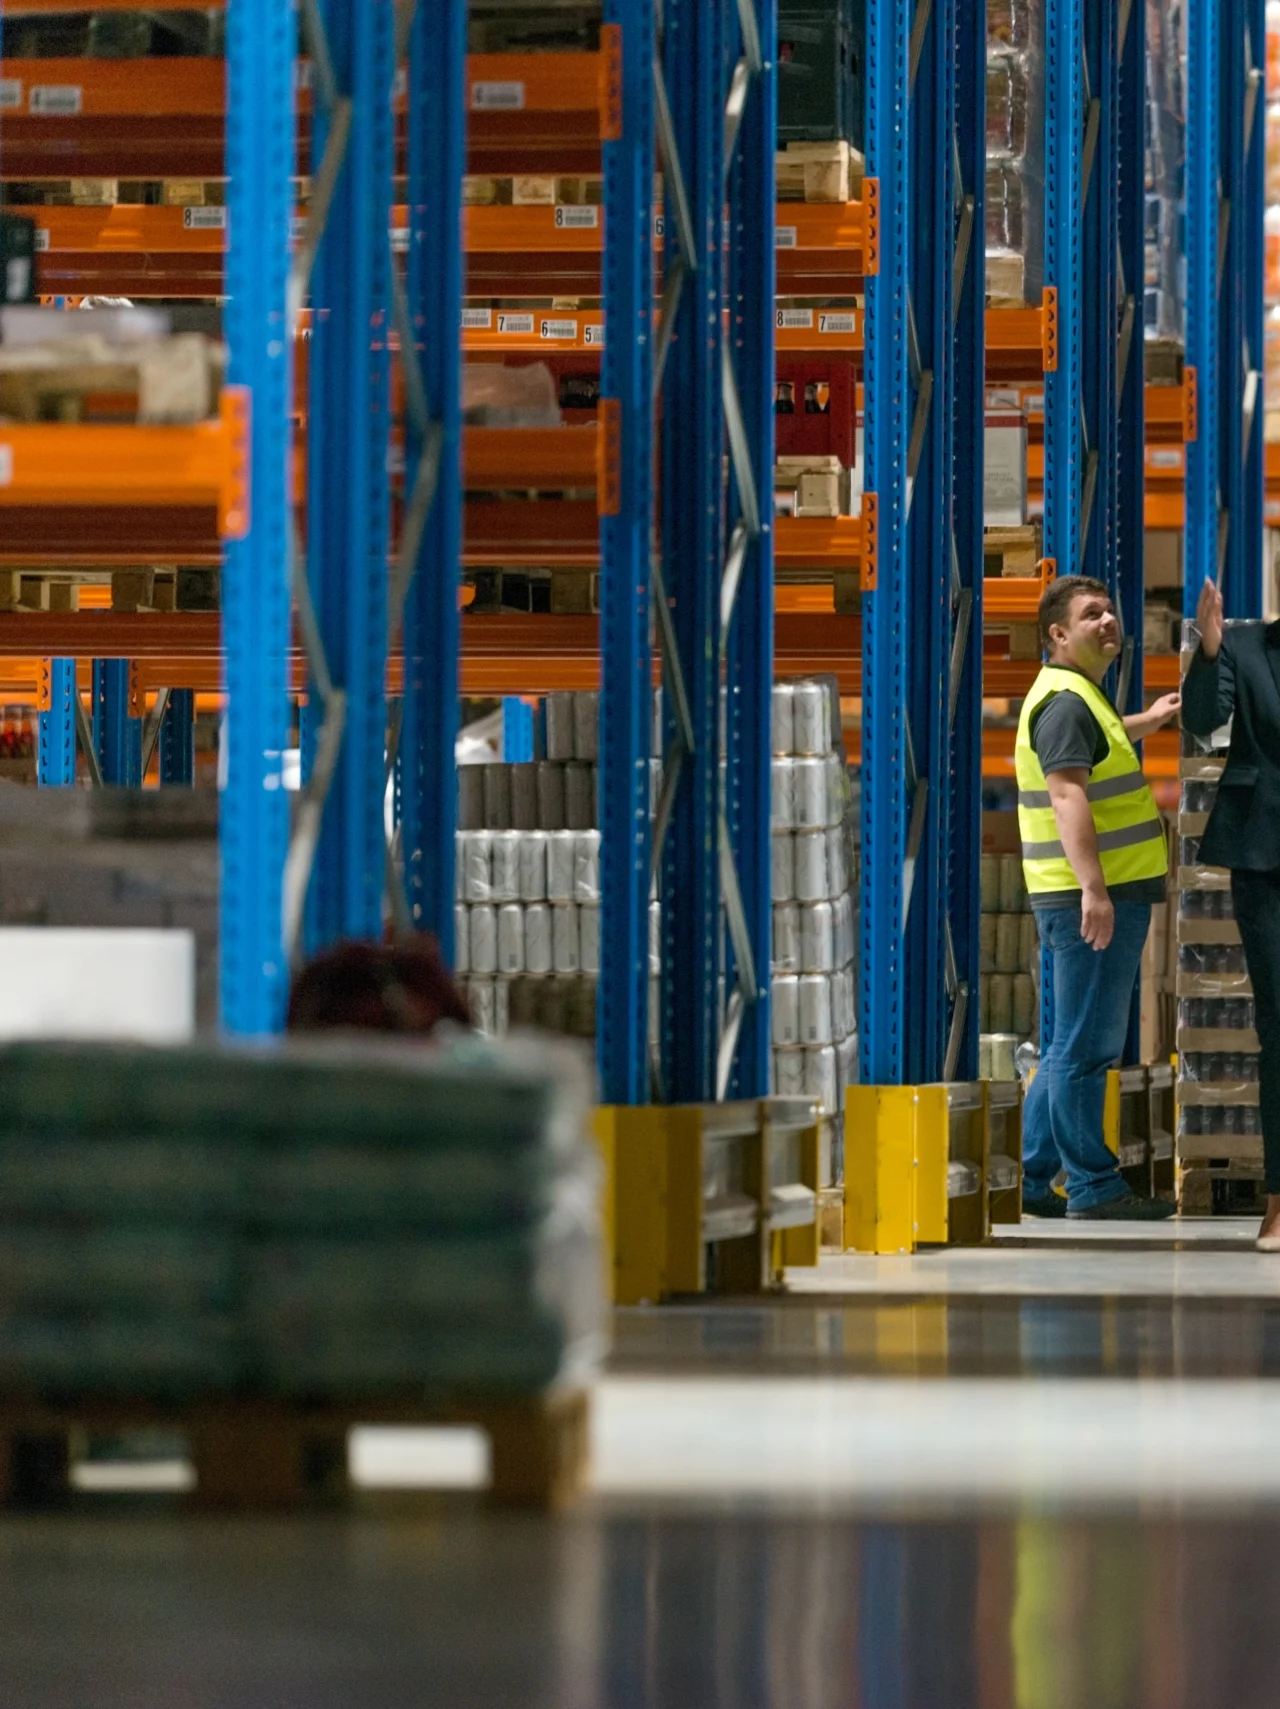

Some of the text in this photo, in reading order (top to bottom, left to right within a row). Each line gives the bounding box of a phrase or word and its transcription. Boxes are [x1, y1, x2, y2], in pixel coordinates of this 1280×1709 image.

[185, 208, 191, 226] 8
[556, 209, 562, 226] 8
[656, 218, 664, 236] 6
[498, 316, 505, 332] 7
[777, 311, 784, 327] 8
[819, 316, 826, 331] 7
[541, 321, 548, 337] 6
[585, 327, 592, 342] 5
